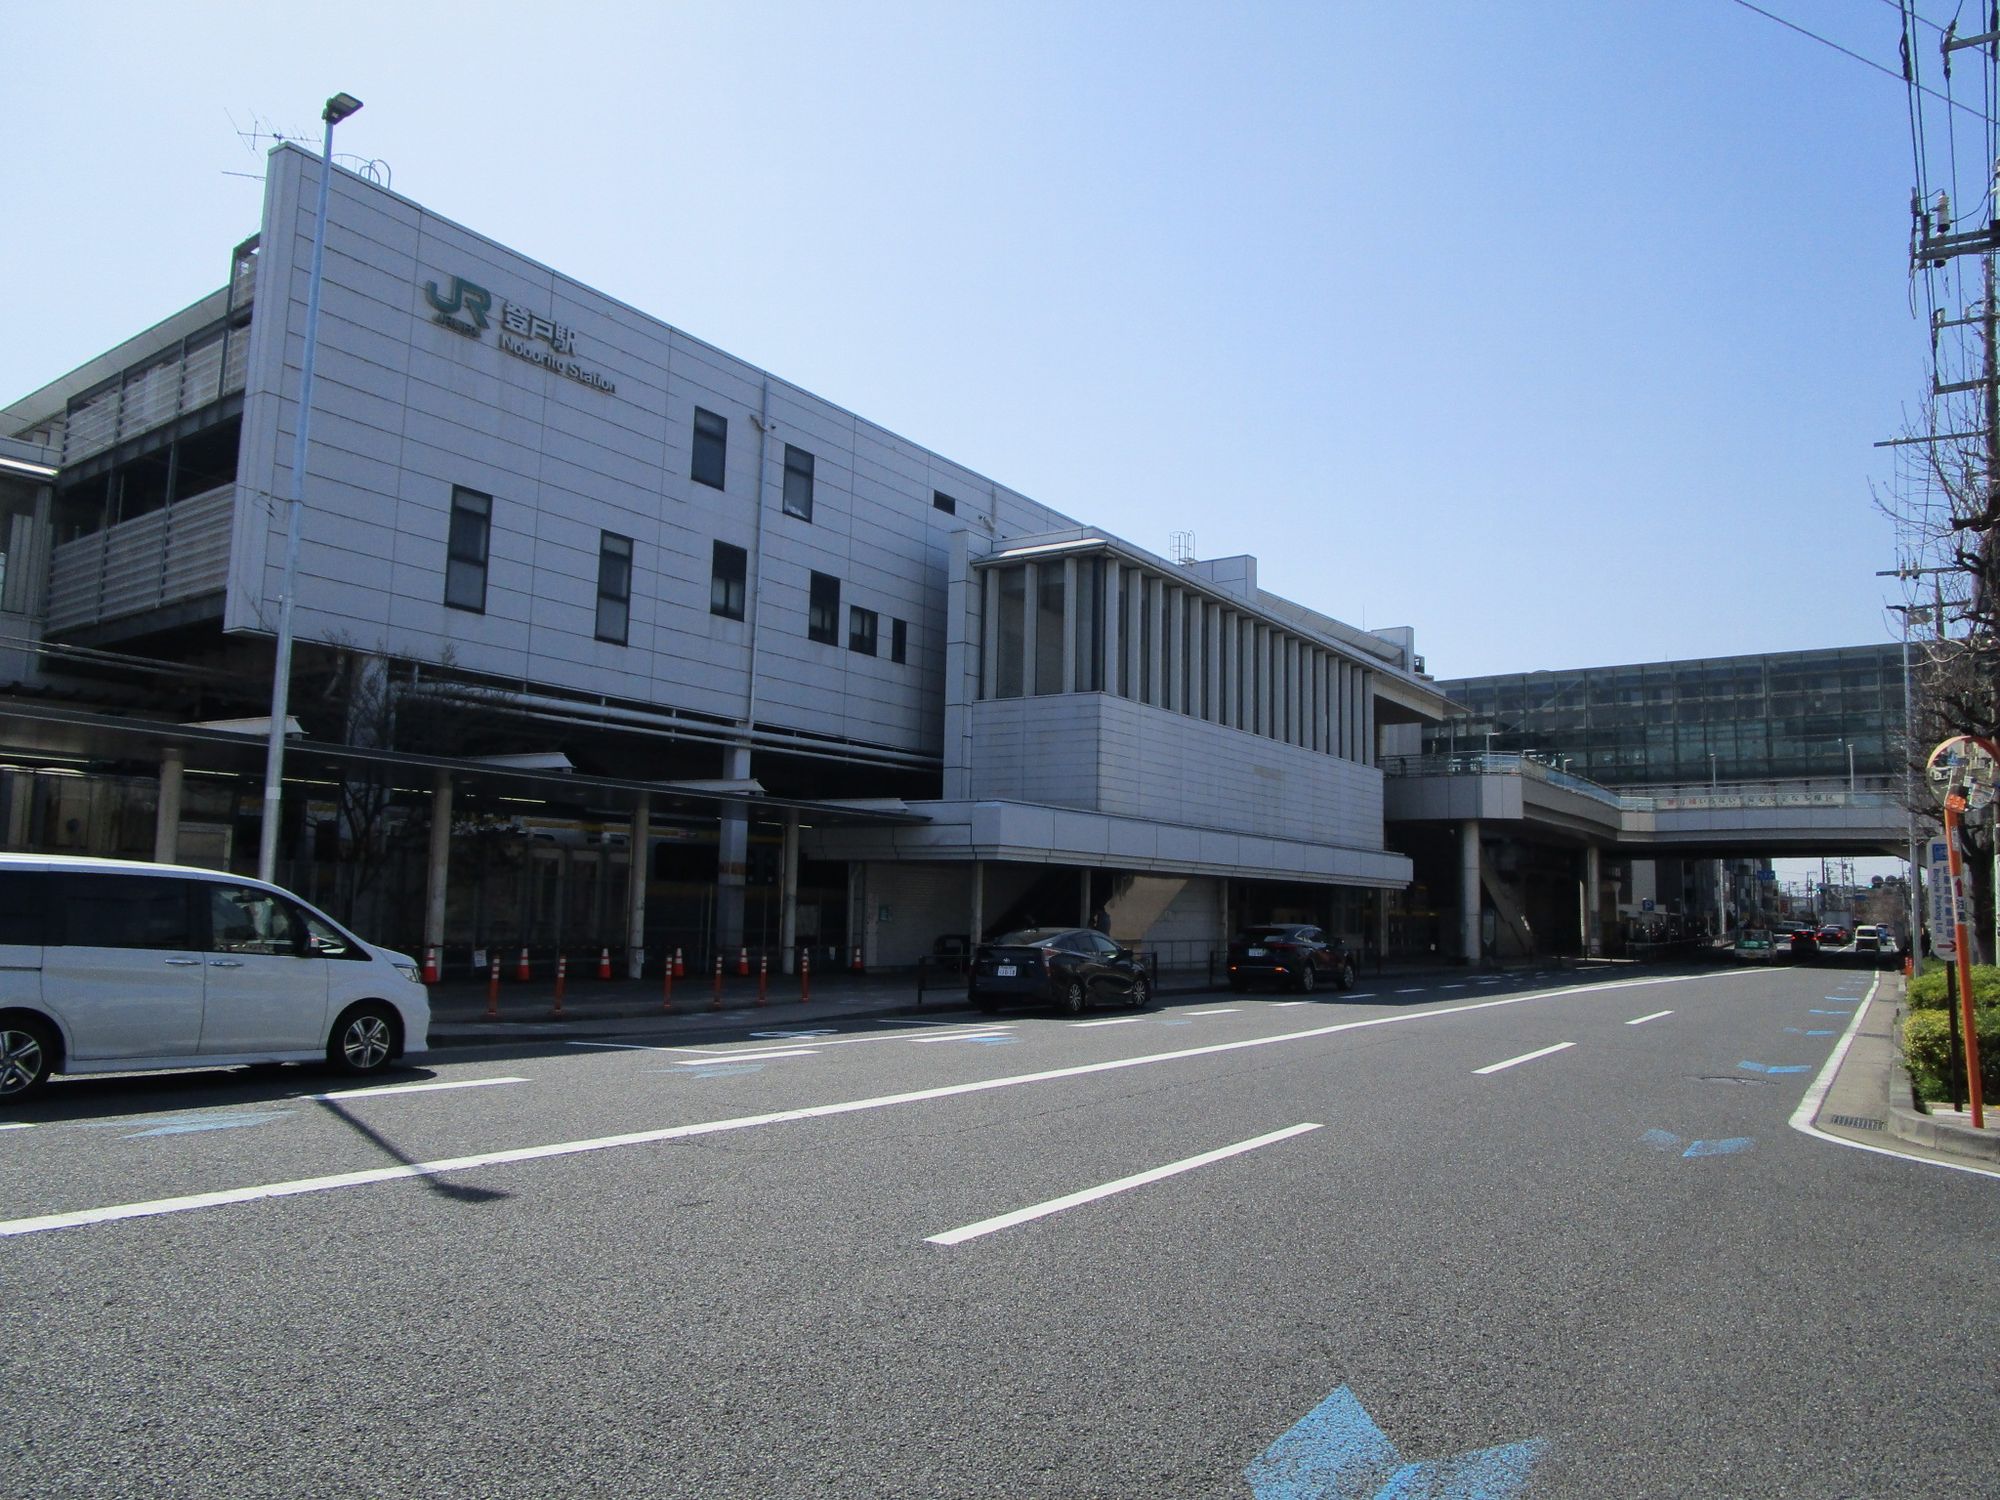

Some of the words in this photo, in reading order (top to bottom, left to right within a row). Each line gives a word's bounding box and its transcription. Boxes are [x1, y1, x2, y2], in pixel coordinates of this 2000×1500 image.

[425, 276, 492, 330] JR
[502, 301, 578, 357] 登戸駅
[501, 334, 567, 376] Noborito
[568, 363, 617, 394] Station
[1935, 895, 1943, 921] Parking
